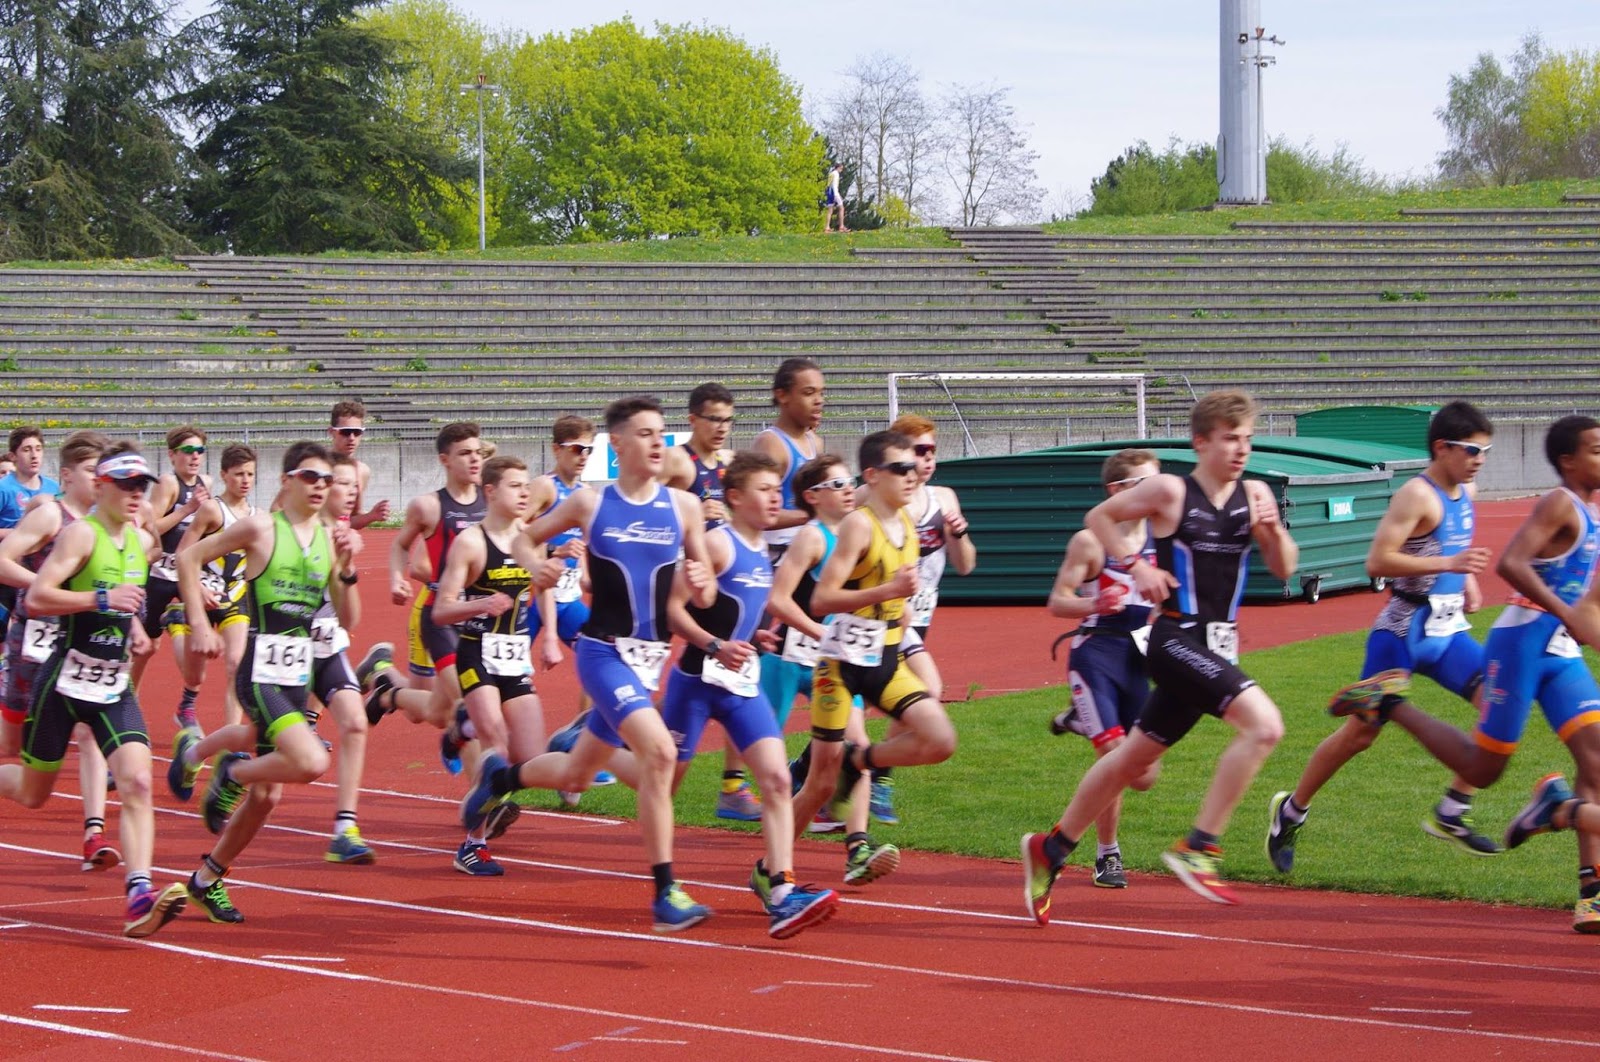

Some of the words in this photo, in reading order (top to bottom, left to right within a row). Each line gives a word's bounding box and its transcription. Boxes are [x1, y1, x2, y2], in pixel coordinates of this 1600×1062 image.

[831, 621, 876, 649] 155
[264, 643, 307, 667] 164
[70, 656, 119, 687] 193
